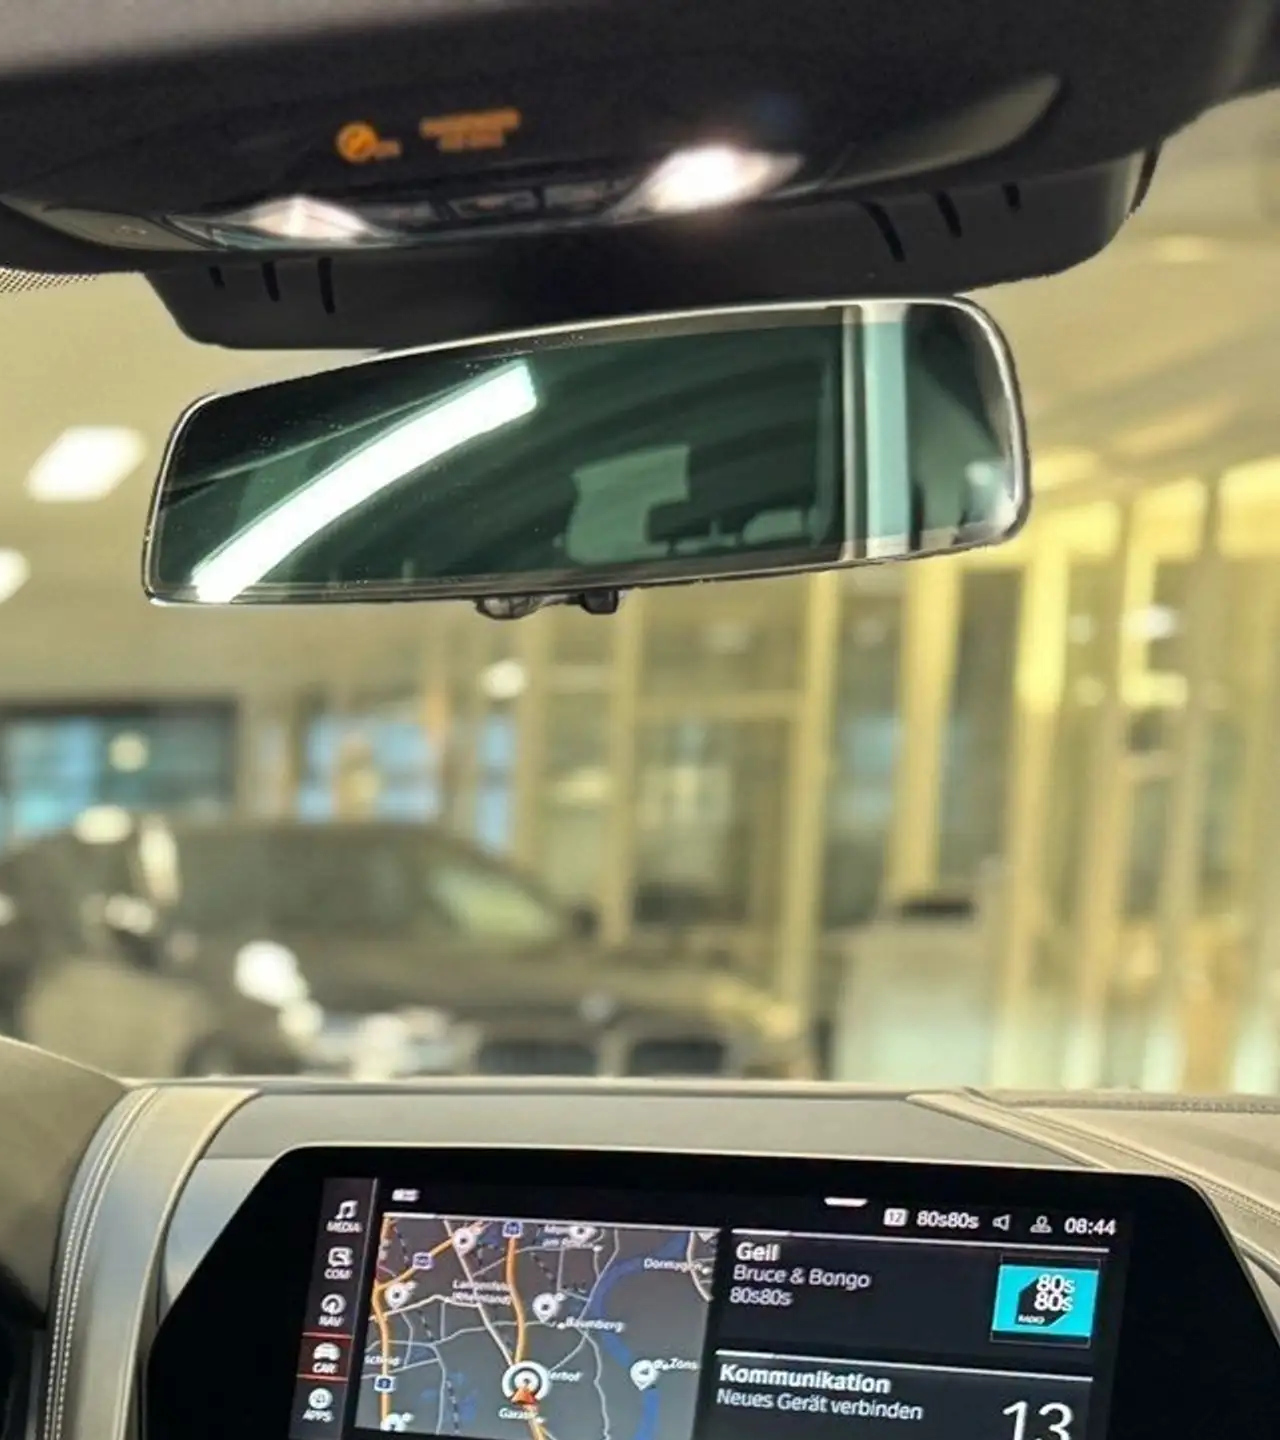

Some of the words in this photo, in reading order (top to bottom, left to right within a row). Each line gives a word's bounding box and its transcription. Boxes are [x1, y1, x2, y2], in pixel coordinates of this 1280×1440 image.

[326, 1221, 362, 1233] MEDIA
[916, 1211, 980, 1229] 80s80s
[1064, 1217, 1117, 1236] 08:44
[733, 1264, 788, 1283] Bruce
[790, 1267, 806, 1285] &
[809, 1268, 872, 1291] Bongo
[1036, 1274, 1076, 1294] 80s
[729, 1286, 793, 1306] 80s80s
[1034, 1291, 1074, 1312] 80s
[318, 1314, 344, 1327] NAV
[312, 1362, 338, 1374] CAR
[719, 1363, 891, 1394] Kommunikation
[716, 1388, 775, 1408] Neues
[777, 1392, 828, 1413] Gerät
[831, 1400, 924, 1421] verbinden
[303, 1409, 335, 1423] APPS
